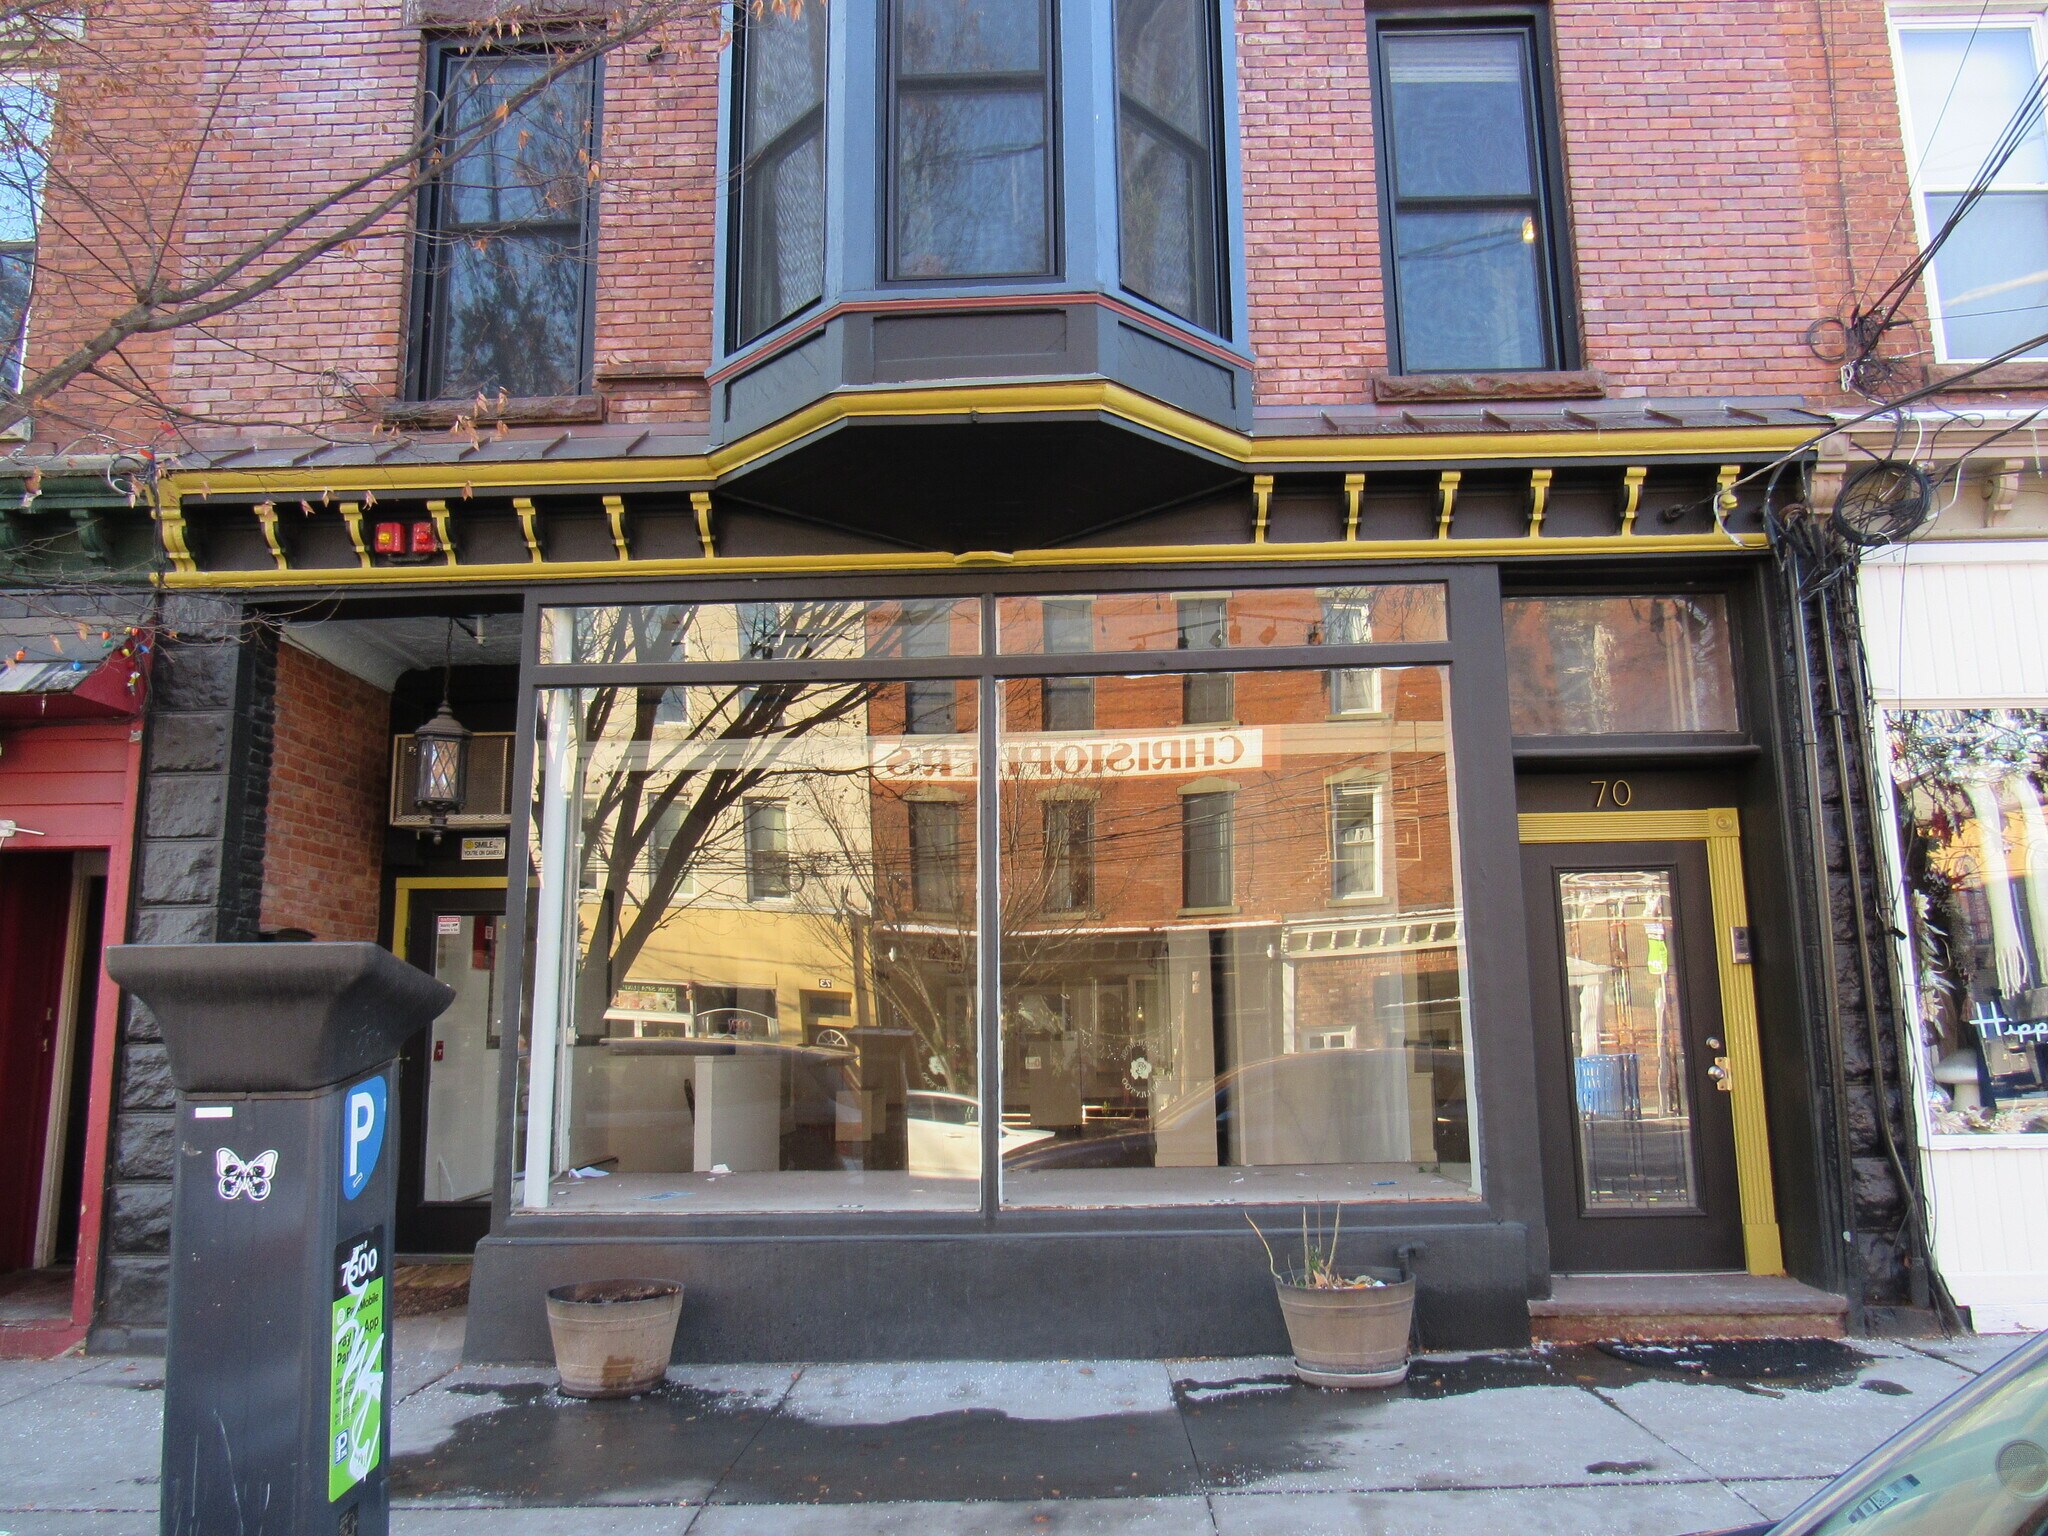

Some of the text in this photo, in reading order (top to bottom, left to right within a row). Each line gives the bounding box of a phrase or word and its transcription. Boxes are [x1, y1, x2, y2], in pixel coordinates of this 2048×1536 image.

[1590, 779, 1631, 808] 70
[474, 841, 493, 849] SMILE
[1968, 1001, 2048, 1043] Hipp
[349, 1092, 375, 1177] P
[364, 1316, 379, 1334] App
